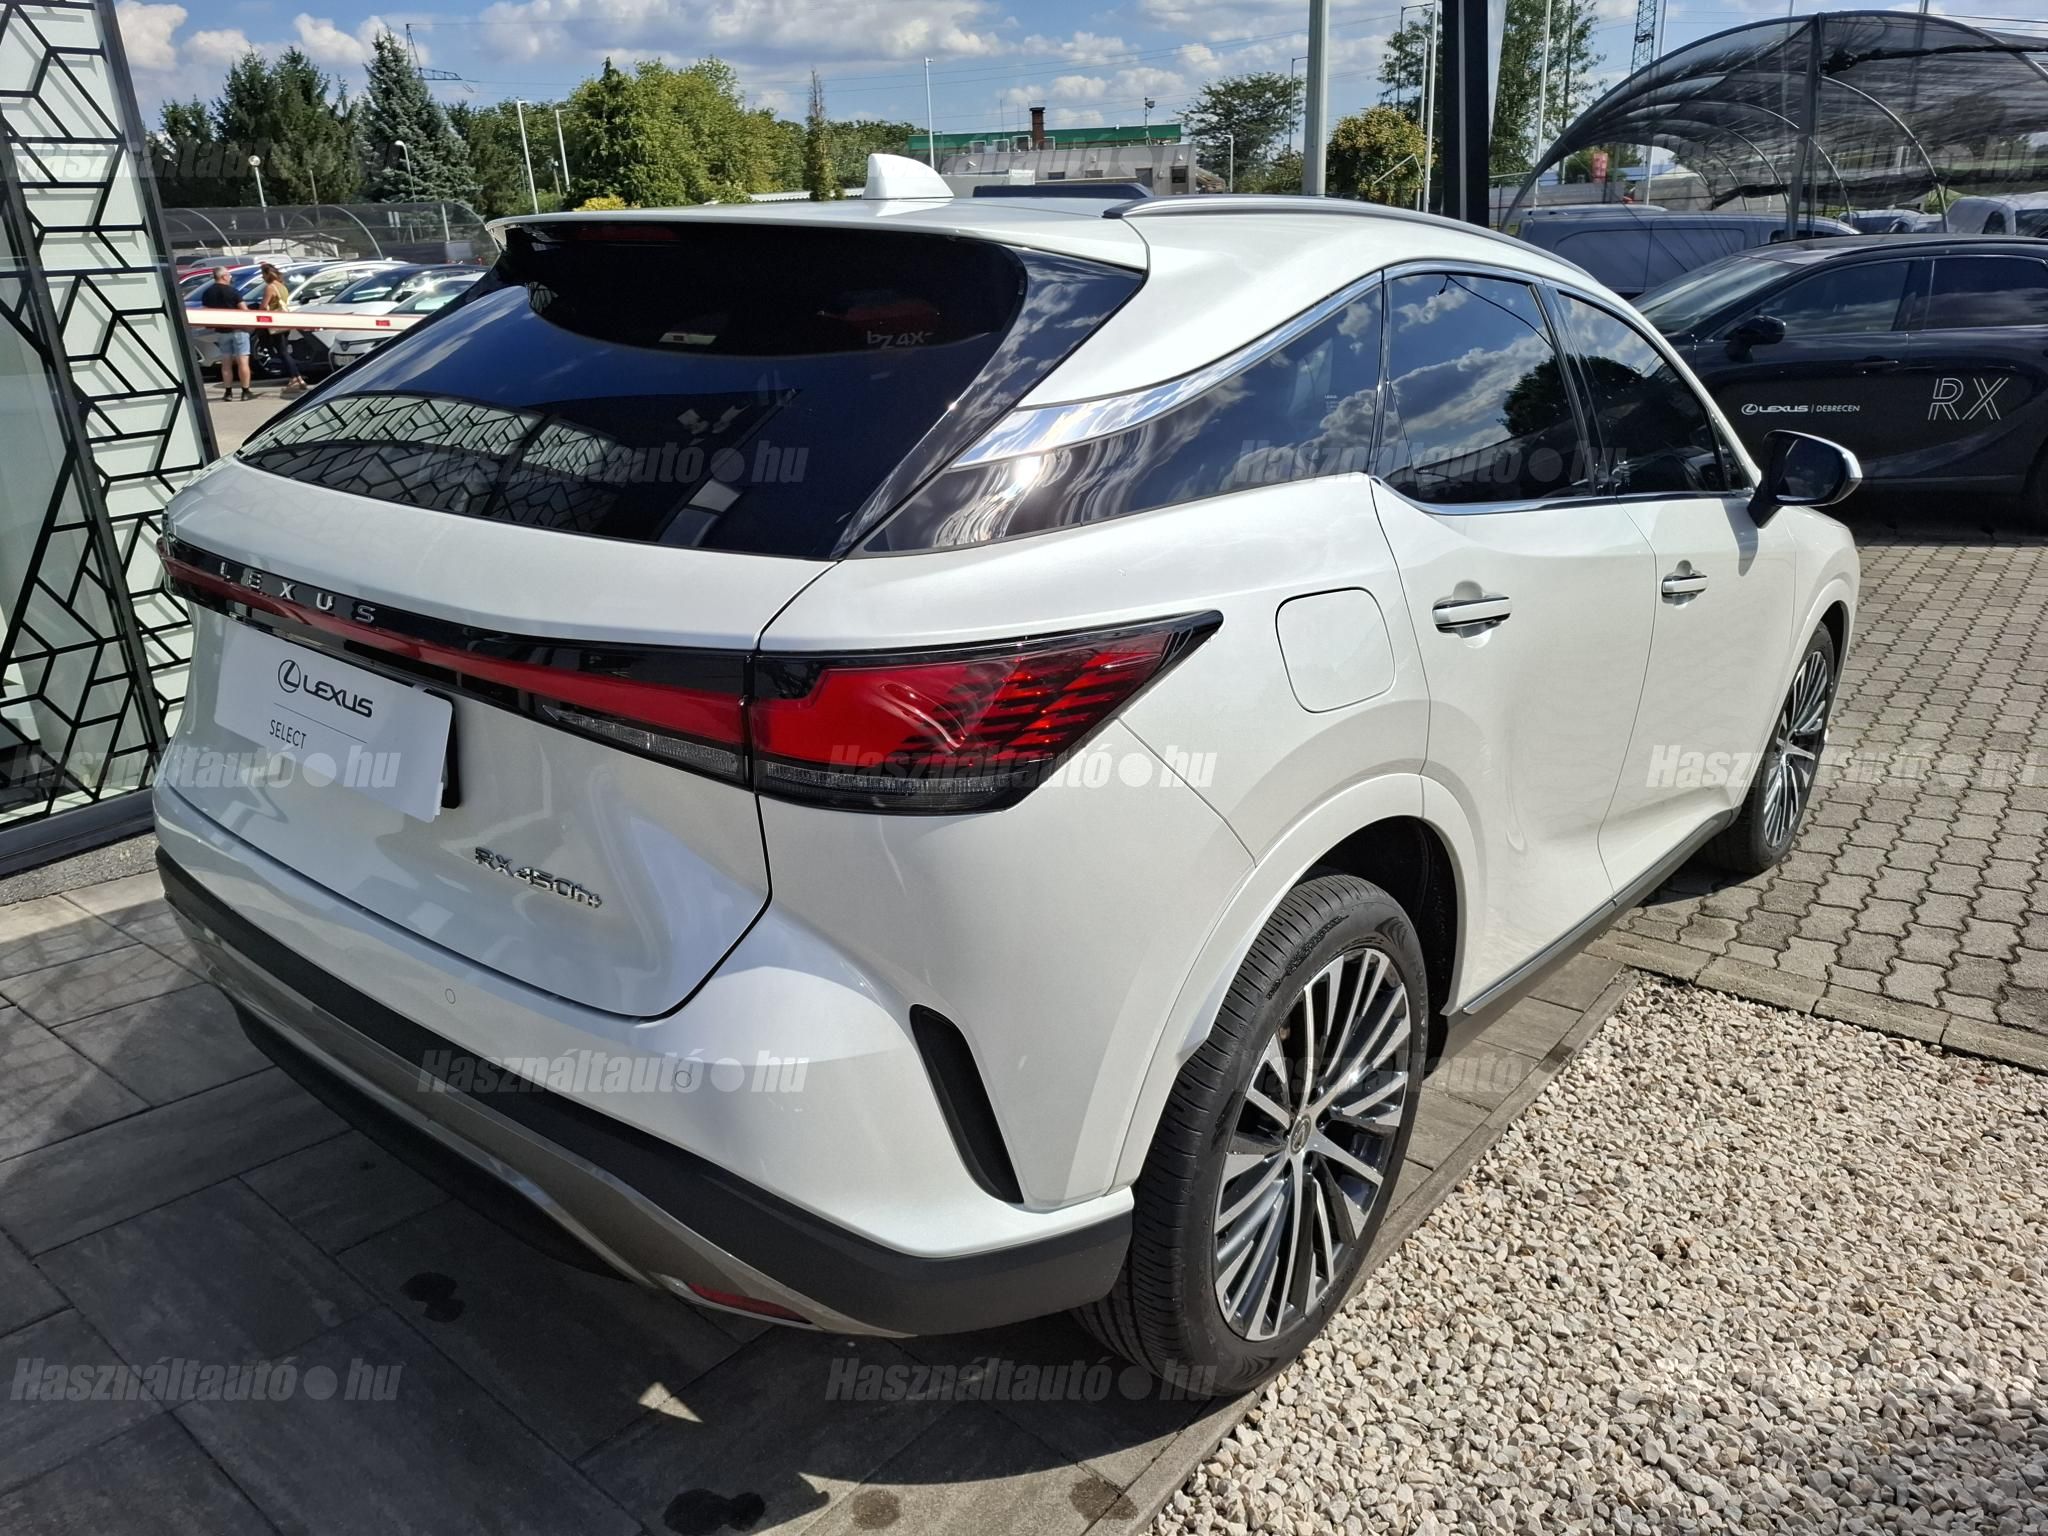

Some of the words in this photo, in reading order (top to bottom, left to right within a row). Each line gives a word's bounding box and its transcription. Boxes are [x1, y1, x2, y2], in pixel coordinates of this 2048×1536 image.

[1759, 405, 1809, 413] LEXUS
[1816, 404, 1860, 413] DEBRECEN
[1927, 377, 2009, 421] RX
[219, 561, 376, 624] LEXUS
[302, 674, 373, 718] LEXUS
[269, 719, 307, 750] SELECT
